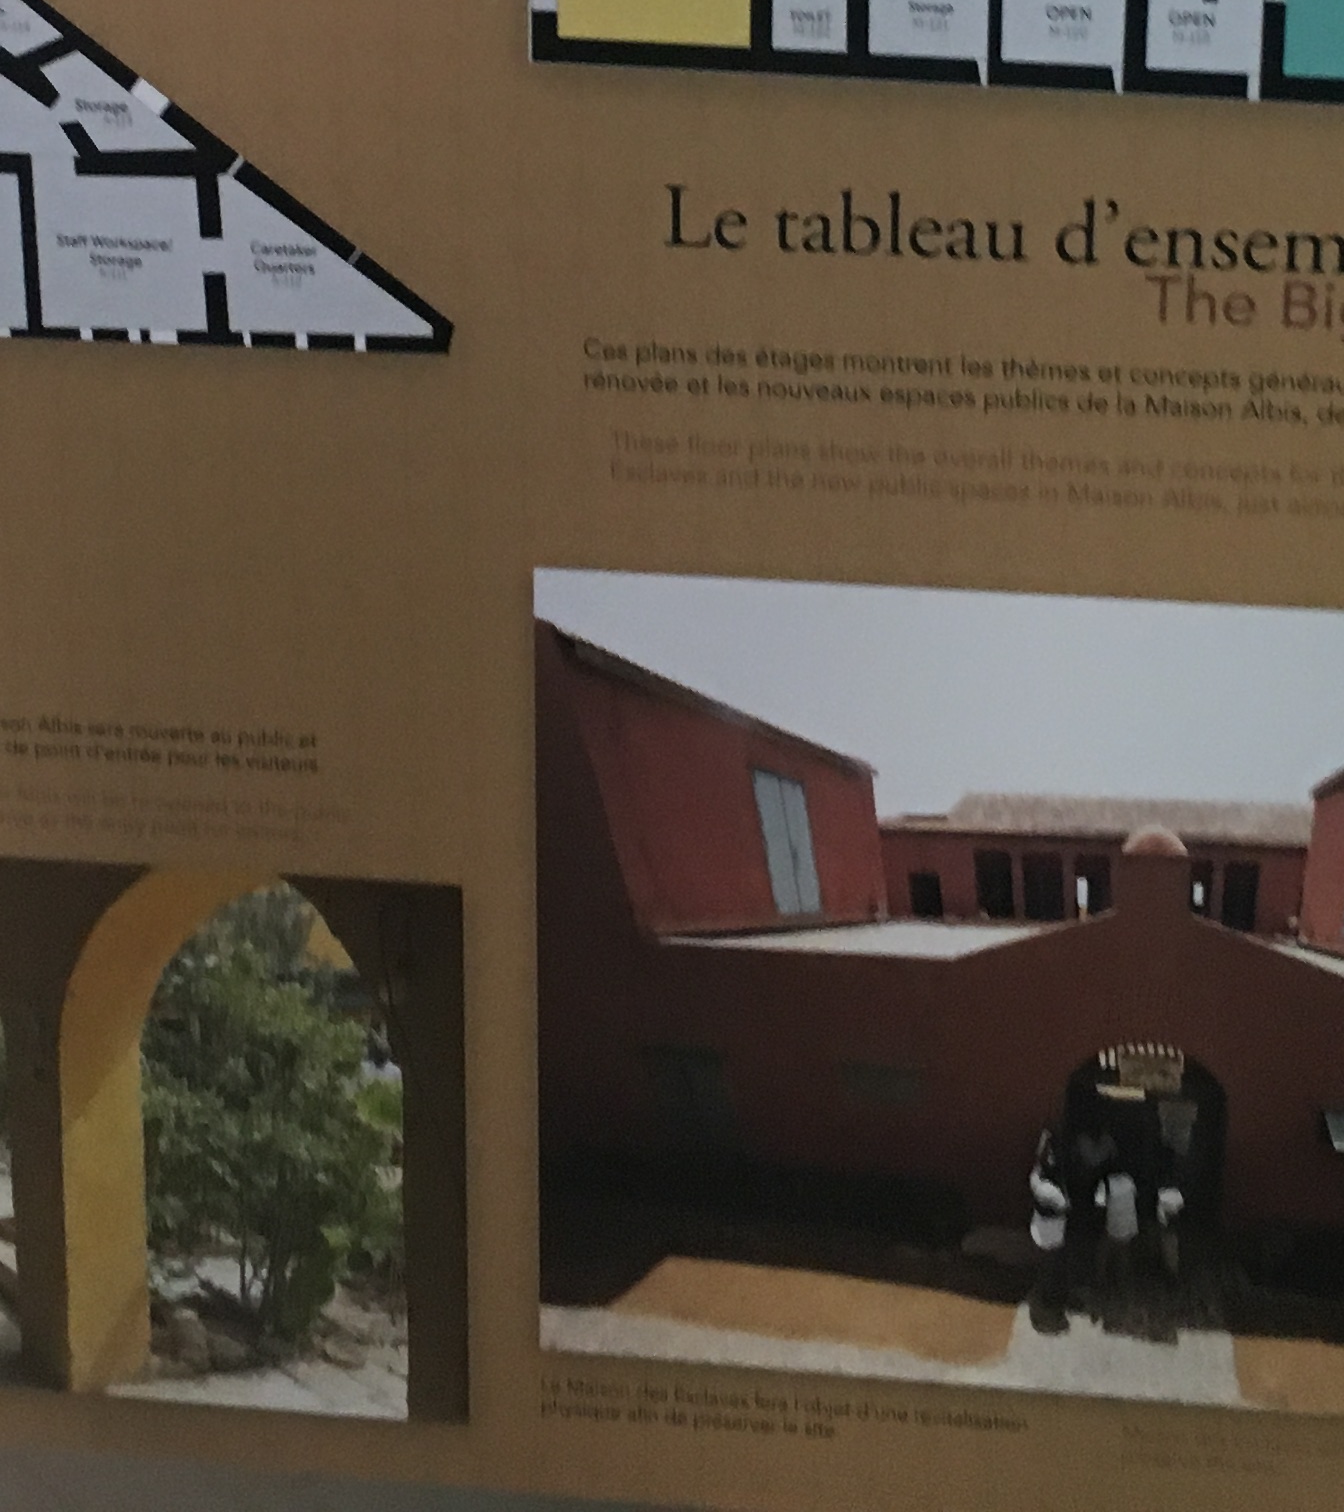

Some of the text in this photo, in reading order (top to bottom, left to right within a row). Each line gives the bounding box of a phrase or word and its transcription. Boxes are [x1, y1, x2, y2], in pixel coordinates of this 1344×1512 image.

[1046, 4, 1092, 23] OPEN
[1168, 9, 1215, 29] OPEN
[663, 182, 748, 251] Le
[775, 187, 1029, 262] tableau
[1143, 272, 1258, 327] The
[582, 335, 1092, 384] Ces plans des étages montrent les thèmes
